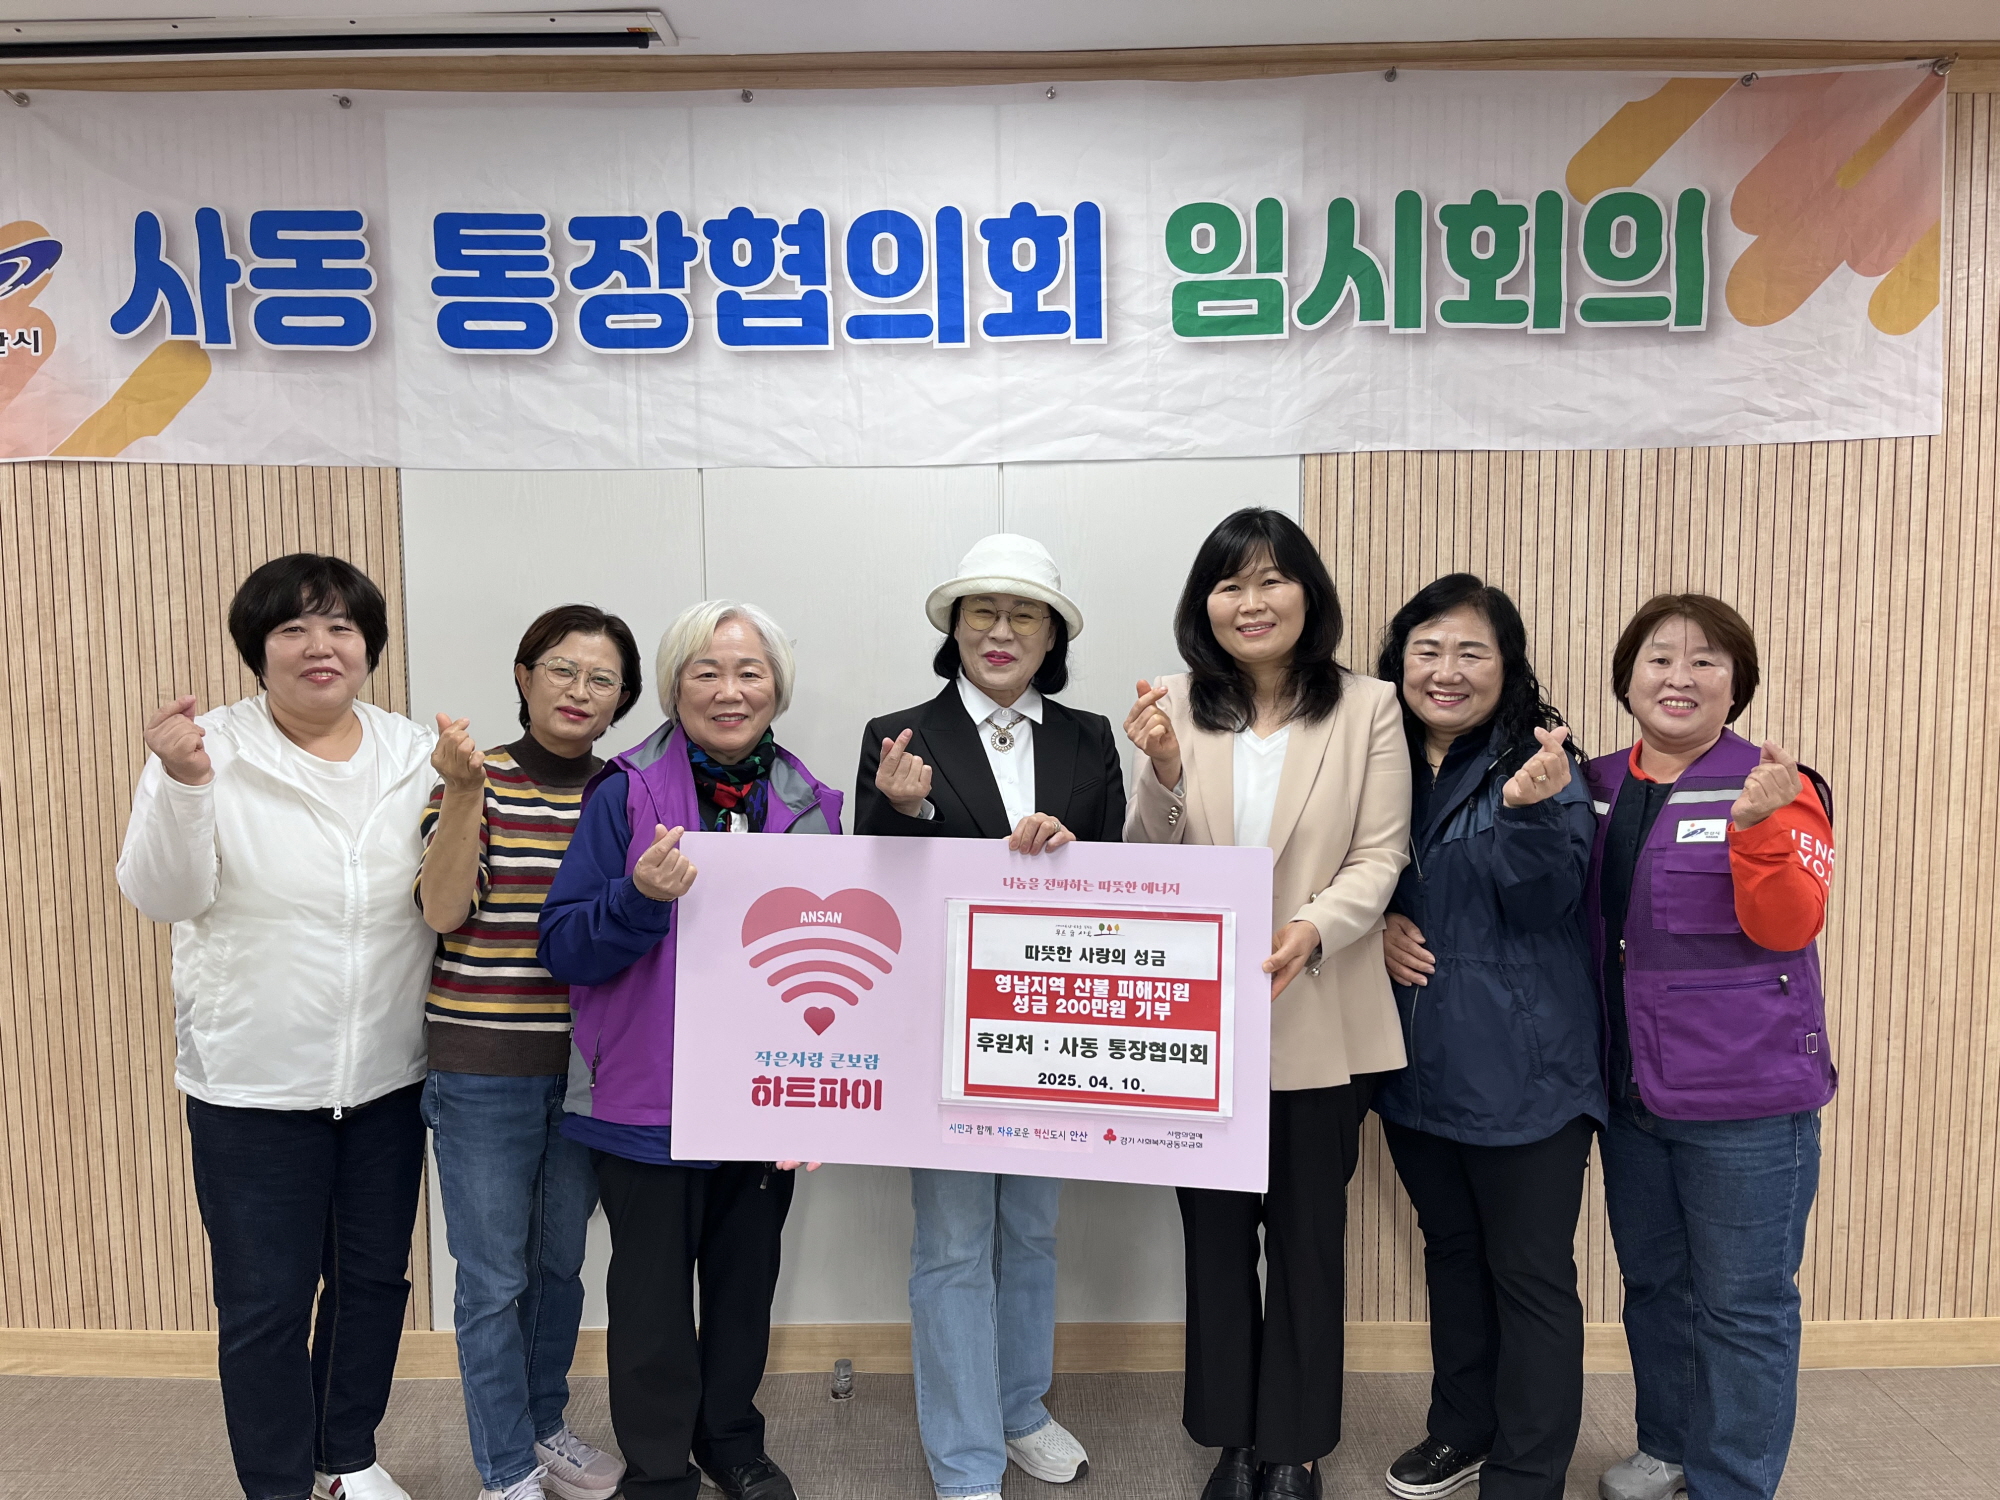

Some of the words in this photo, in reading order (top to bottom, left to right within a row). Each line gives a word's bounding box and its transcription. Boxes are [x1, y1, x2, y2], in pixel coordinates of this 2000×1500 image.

[109, 206, 379, 349] 사동
[430, 200, 1105, 352] 통장협의회
[1164, 187, 1706, 340] 임시회의
[1002, 877, 1040, 890] 나눔을
[1043, 878, 1094, 892] 전파하는
[1098, 880, 1137, 894] 따뜻한
[1141, 882, 1180, 895] 에너지
[800, 911, 842, 924] ANSAN
[1025, 945, 1072, 962] 따뜻한
[1079, 947, 1126, 965] 사랑의
[1134, 950, 1166, 967] 성금
[995, 974, 1065, 995] 영남지역
[1074, 978, 1110, 998] 산불
[1117, 979, 1190, 1002] 피해지원
[1012, 995, 1048, 1014] 성금
[1056, 999, 1126, 1018] 200만원
[1135, 1001, 1172, 1021] 기부
[977, 1031, 1033, 1055] 후원처
[1059, 1036, 1099, 1059] 사동
[1108, 1038, 1208, 1065] 통장협의회
[755, 1051, 824, 1068] 작은사랑
[829, 1053, 880, 1070] 큰보람
[1038, 1073, 1082, 1088] 2025.
[1089, 1076, 1113, 1090] 04.
[1122, 1078, 1146, 1092] 10.
[752, 1075, 882, 1111] 하트파이
[949, 1124, 973, 1135] 시민과
[997, 1126, 1030, 1138] 자유로운
[1033, 1128, 1066, 1141] 혁신도시
[1069, 1131, 1088, 1143] 안산
[1120, 1136, 1135, 1145] 경기
